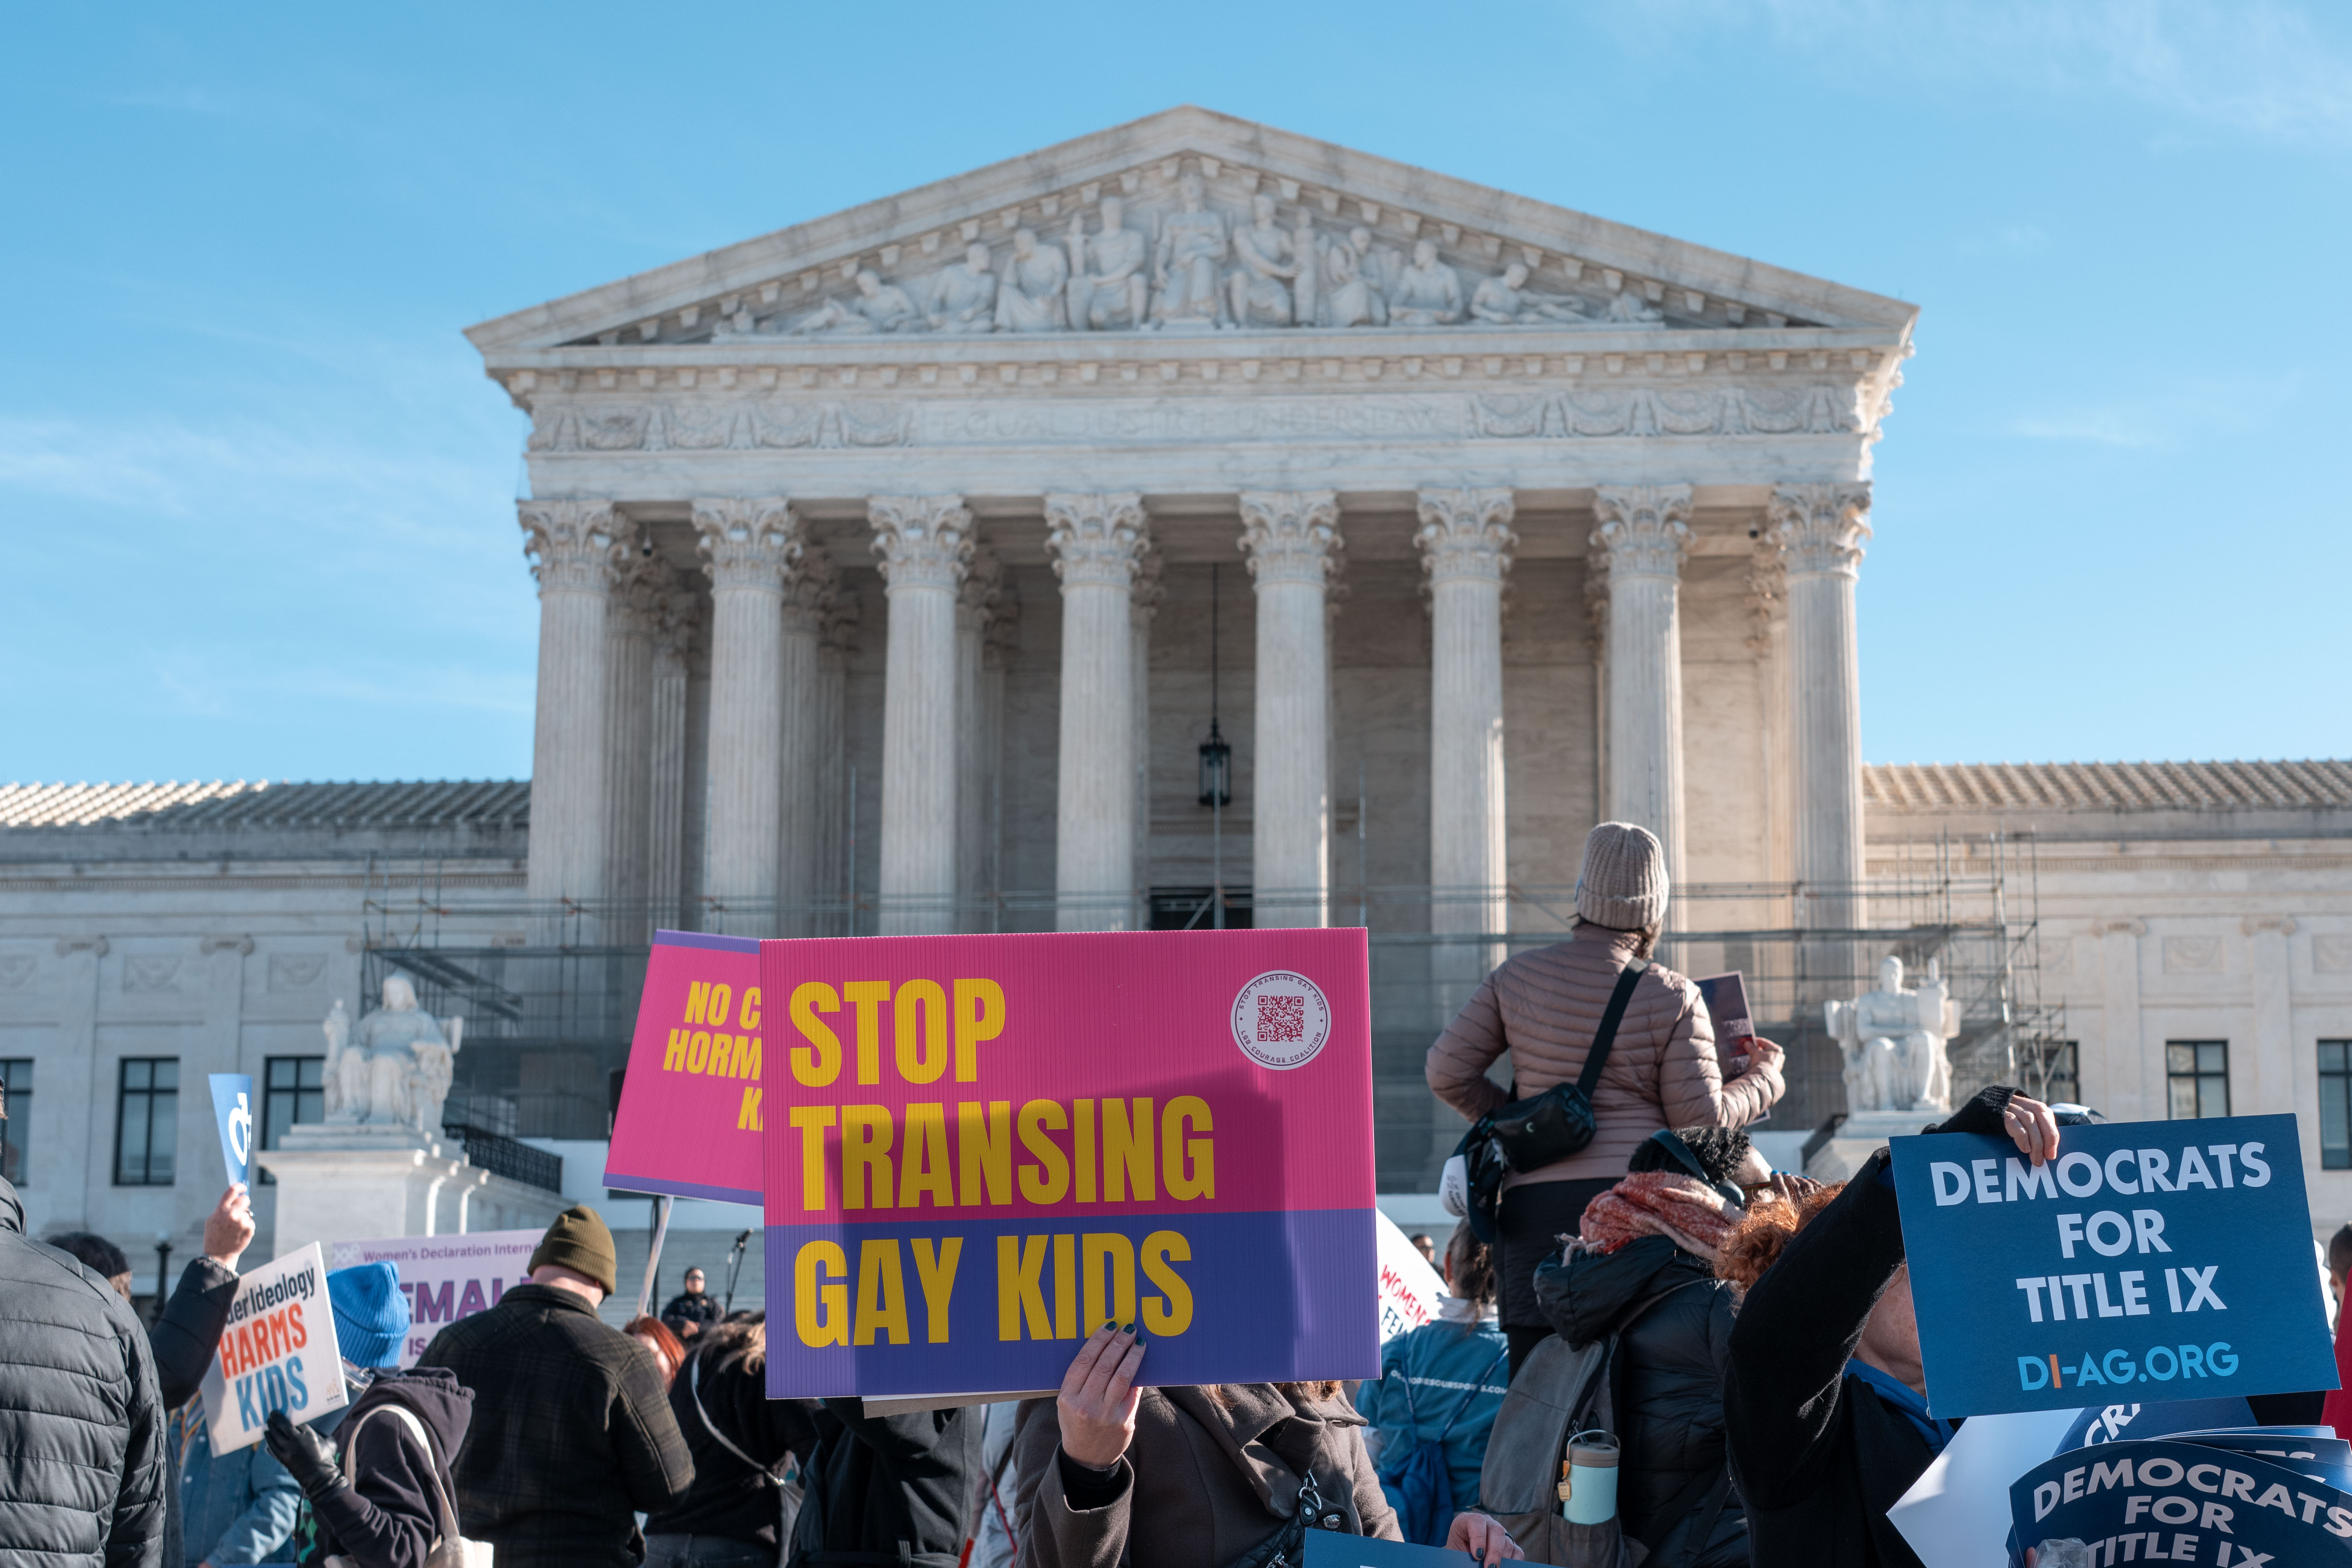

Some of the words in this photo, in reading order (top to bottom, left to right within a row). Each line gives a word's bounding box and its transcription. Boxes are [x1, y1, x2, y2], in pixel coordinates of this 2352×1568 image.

[943, 409, 1058, 437] EQUAL
[1075, 407, 1214, 435] JUSTICE
[1235, 405, 1356, 434] UNDER
[1370, 405, 1438, 432] LAW
[685, 981, 731, 1026] NO
[1239, 990, 1251, 1010] STOP
[1254, 975, 1293, 988] TRANSING
[1298, 980, 1312, 991] GAY
[1313, 993, 1323, 1011] KIDS
[790, 979, 1005, 1087] STOP
[790, 1096, 1214, 1210] TRANSING
[1931, 1142, 2270, 1205] DEMOCRATS
[363, 1249, 417, 1262] Women's
[421, 1244, 492, 1259] Declaration
[2057, 1210, 2172, 1258] FOR
[250, 1267, 315, 1314] Ideology
[795, 1237, 963, 1347] GAY
[997, 1231, 1193, 1341] KIDS
[2016, 1271, 2149, 1322] TITLE
[2165, 1266, 2227, 1312] IX
[219, 1303, 307, 1380] HARMS
[2017, 1342, 2239, 1391] DI-AG.ORG
[235, 1355, 309, 1433] KIDS
[2034, 1458, 2352, 1538] DEMOCRATS
[2124, 1495, 2234, 1534] FOR
[2087, 1532, 2199, 1568] TITLE
[2216, 1541, 2275, 1568] IX
